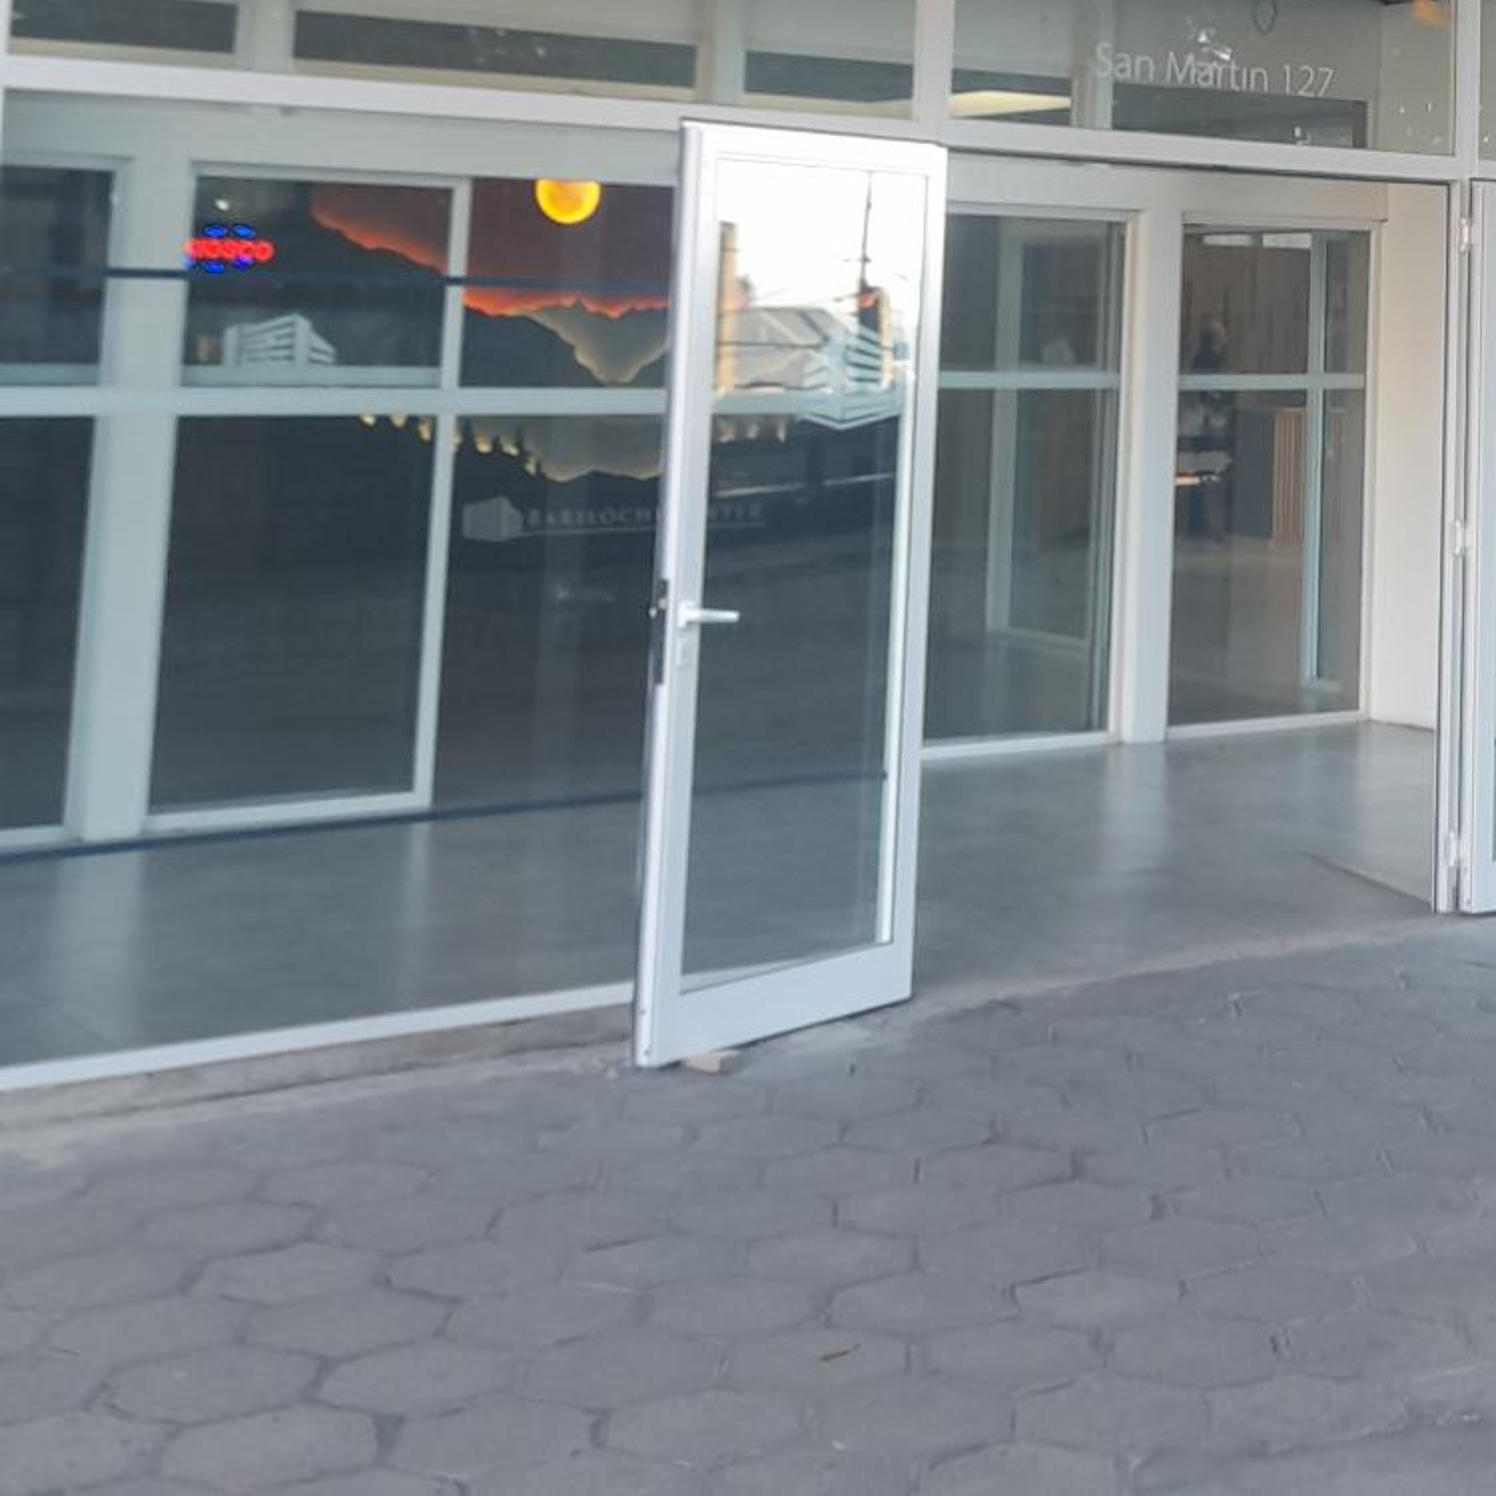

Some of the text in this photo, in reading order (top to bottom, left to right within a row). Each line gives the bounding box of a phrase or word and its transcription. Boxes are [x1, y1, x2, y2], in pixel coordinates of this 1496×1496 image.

[1095, 42, 1156, 82] San
[1281, 63, 1336, 98] 127
[527, 507, 655, 527] BARILOCH
